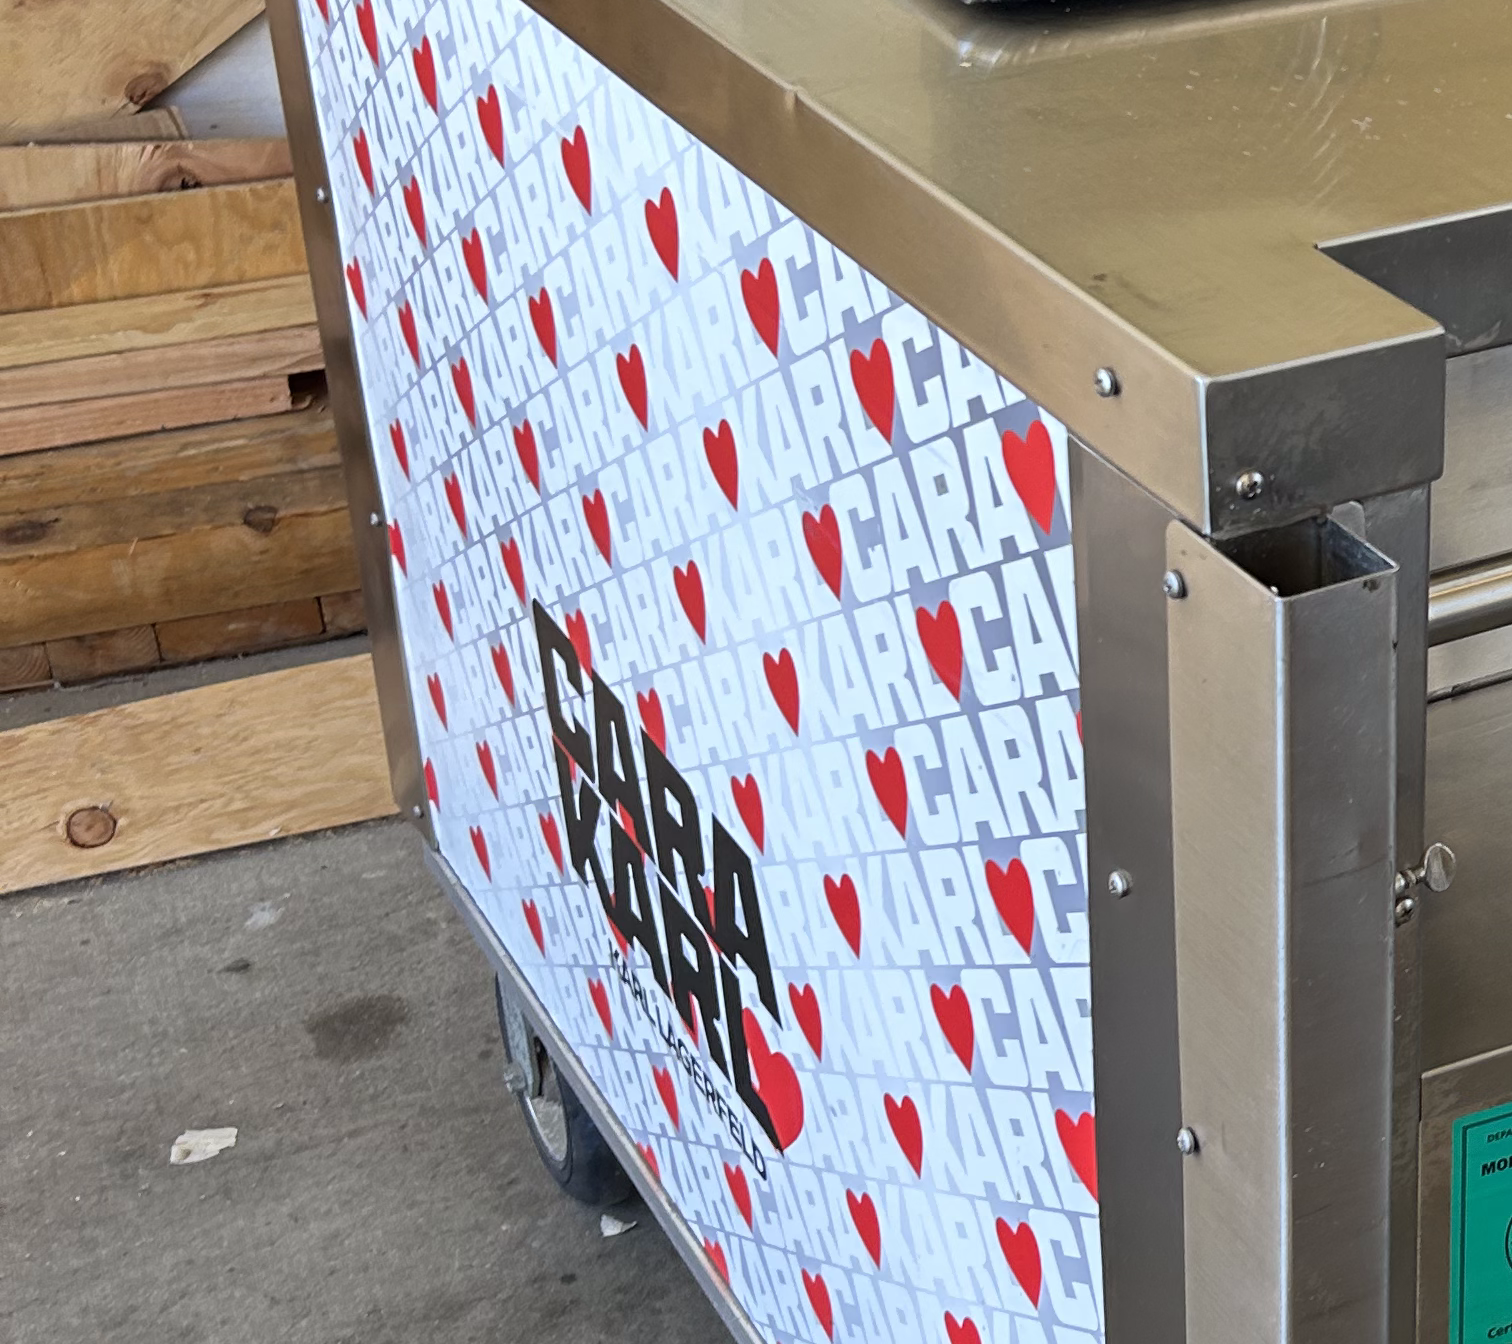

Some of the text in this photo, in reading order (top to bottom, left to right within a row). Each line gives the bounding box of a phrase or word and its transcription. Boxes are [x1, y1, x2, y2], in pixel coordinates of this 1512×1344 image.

[533, 598, 781, 1030] CARA
[554, 737, 784, 1154] KARL
[608, 938, 656, 1026] KARL
[656, 1004, 767, 1181] LAGERFELD
